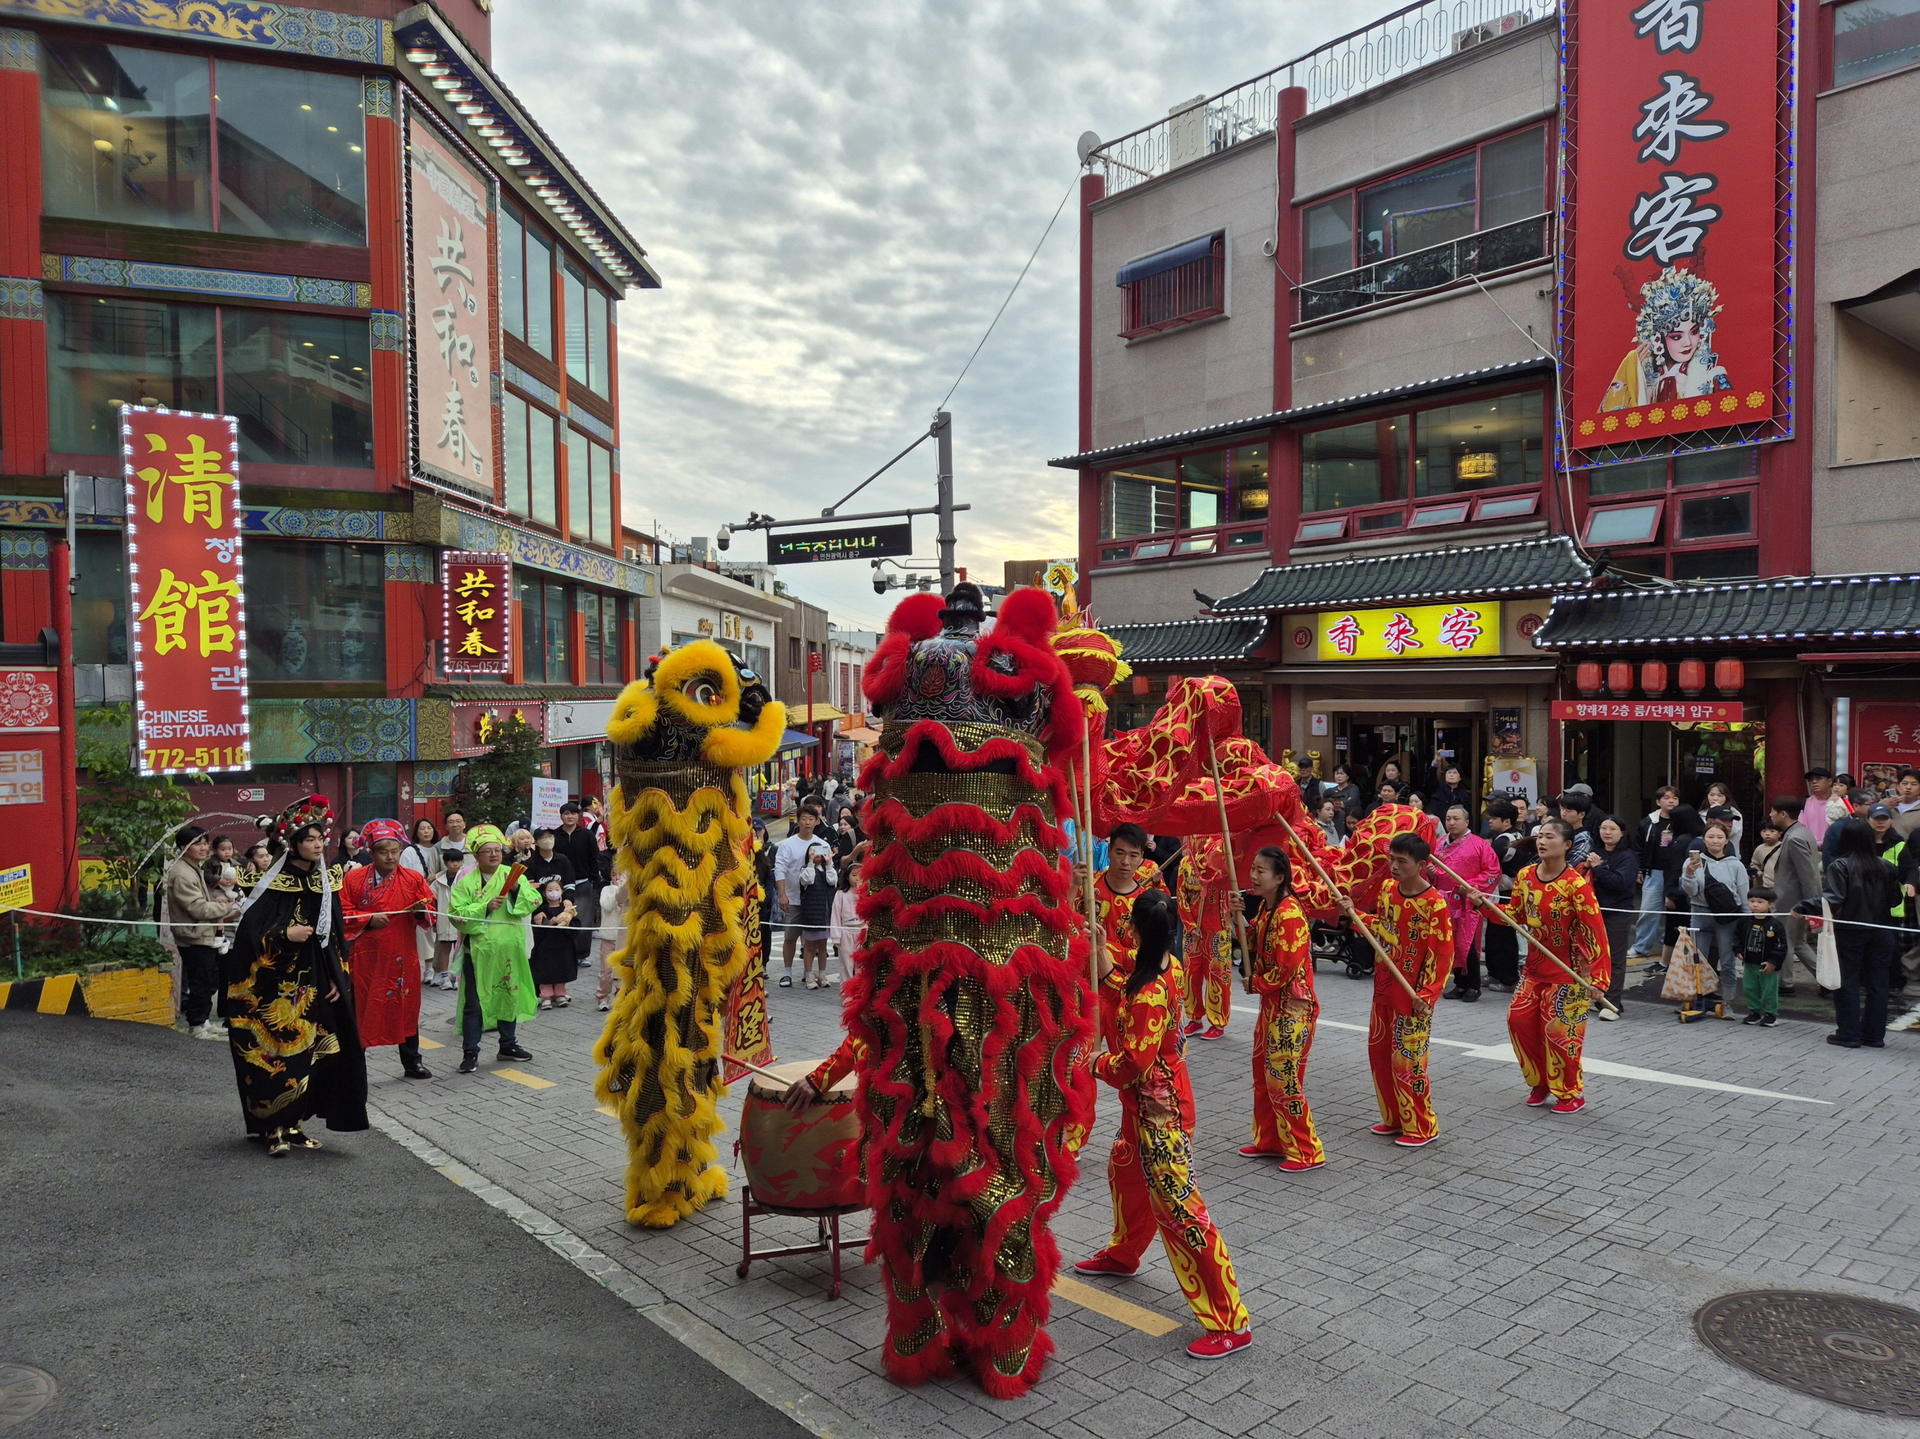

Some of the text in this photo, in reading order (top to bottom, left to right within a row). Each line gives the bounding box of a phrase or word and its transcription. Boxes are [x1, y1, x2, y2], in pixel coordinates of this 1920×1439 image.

[454, 568, 500, 657] 共和春
[1328, 607, 1482, 656] 香來客
[142, 710, 208, 725] CHINESE
[1576, 704, 1608, 717] 향래객
[1612, 705, 1631, 716] 2층
[1690, 705, 1714, 718] 입구
[143, 723, 245, 740] RESTAURANT
[144, 746, 247, 770] 772-5118
